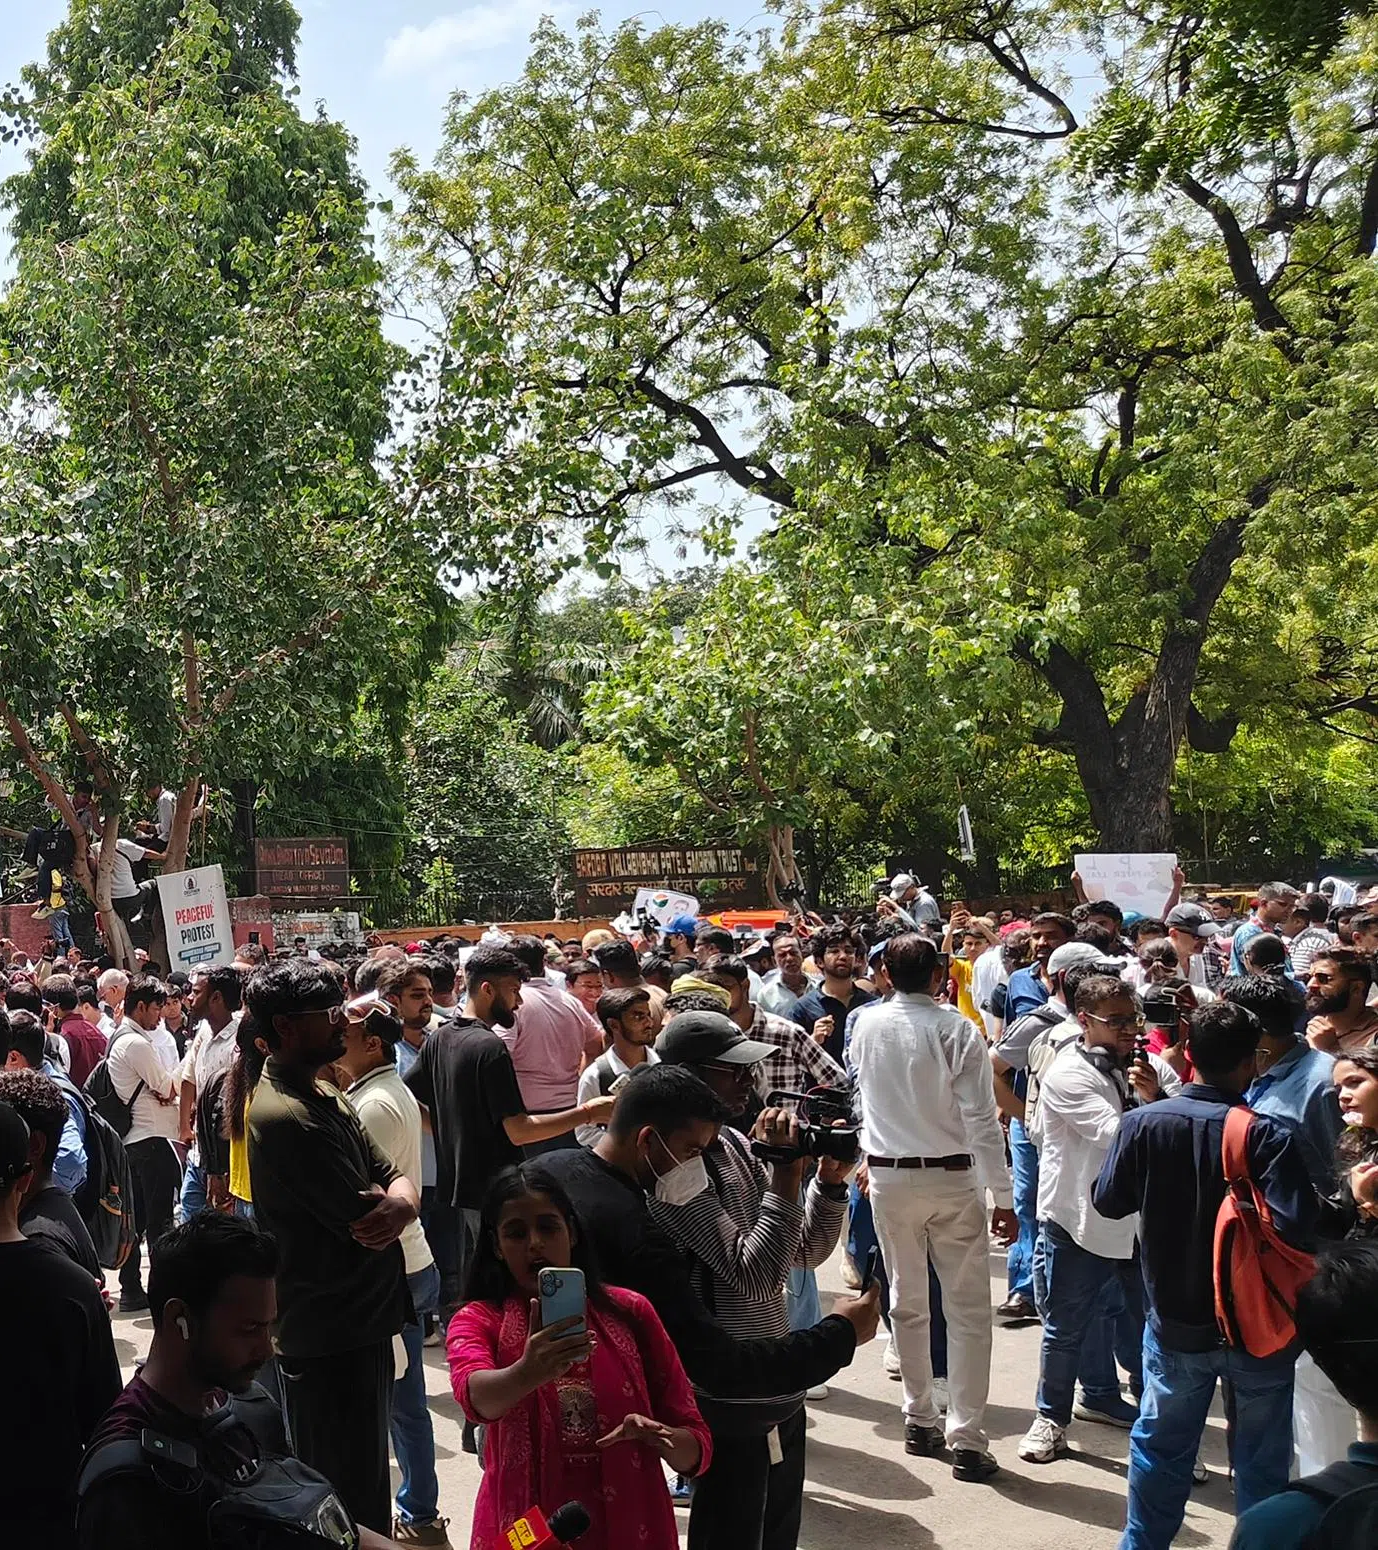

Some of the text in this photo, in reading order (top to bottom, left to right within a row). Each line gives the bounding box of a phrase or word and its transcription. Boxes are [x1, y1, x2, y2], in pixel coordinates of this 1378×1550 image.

[576, 852, 608, 877] SARDAR
[660, 851, 686, 875] PATEL
[716, 849, 742, 873] TRUST
[586, 882, 622, 897] सरदार
[175, 903, 215, 925] PEACEFUL
[181, 923, 216, 944] PROTEST
